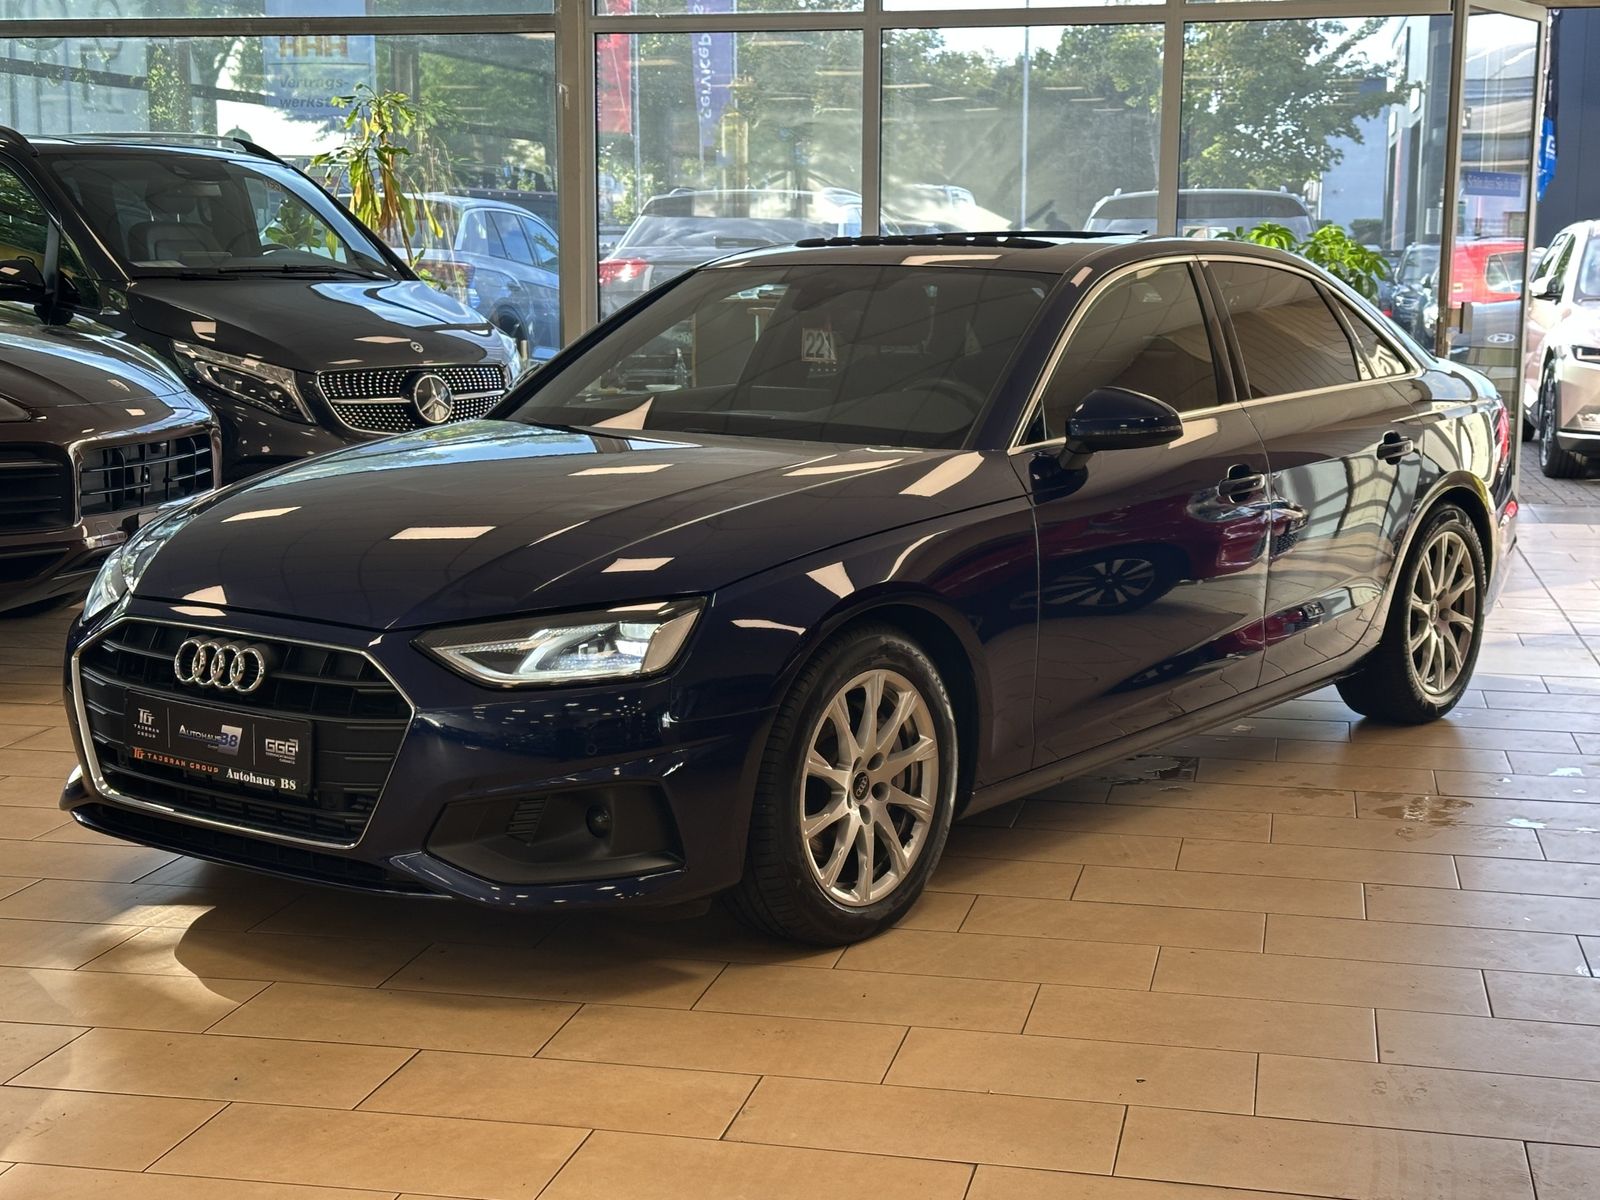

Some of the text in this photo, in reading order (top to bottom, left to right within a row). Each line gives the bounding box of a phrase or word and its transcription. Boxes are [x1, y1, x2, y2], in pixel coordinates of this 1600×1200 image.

[280, 75, 350, 91] Vertrags-
[137, 730, 156, 739] GROUP
[147, 753, 219, 773] TAJERAN GROUP
[226, 768, 297, 791] Autohaus B8
